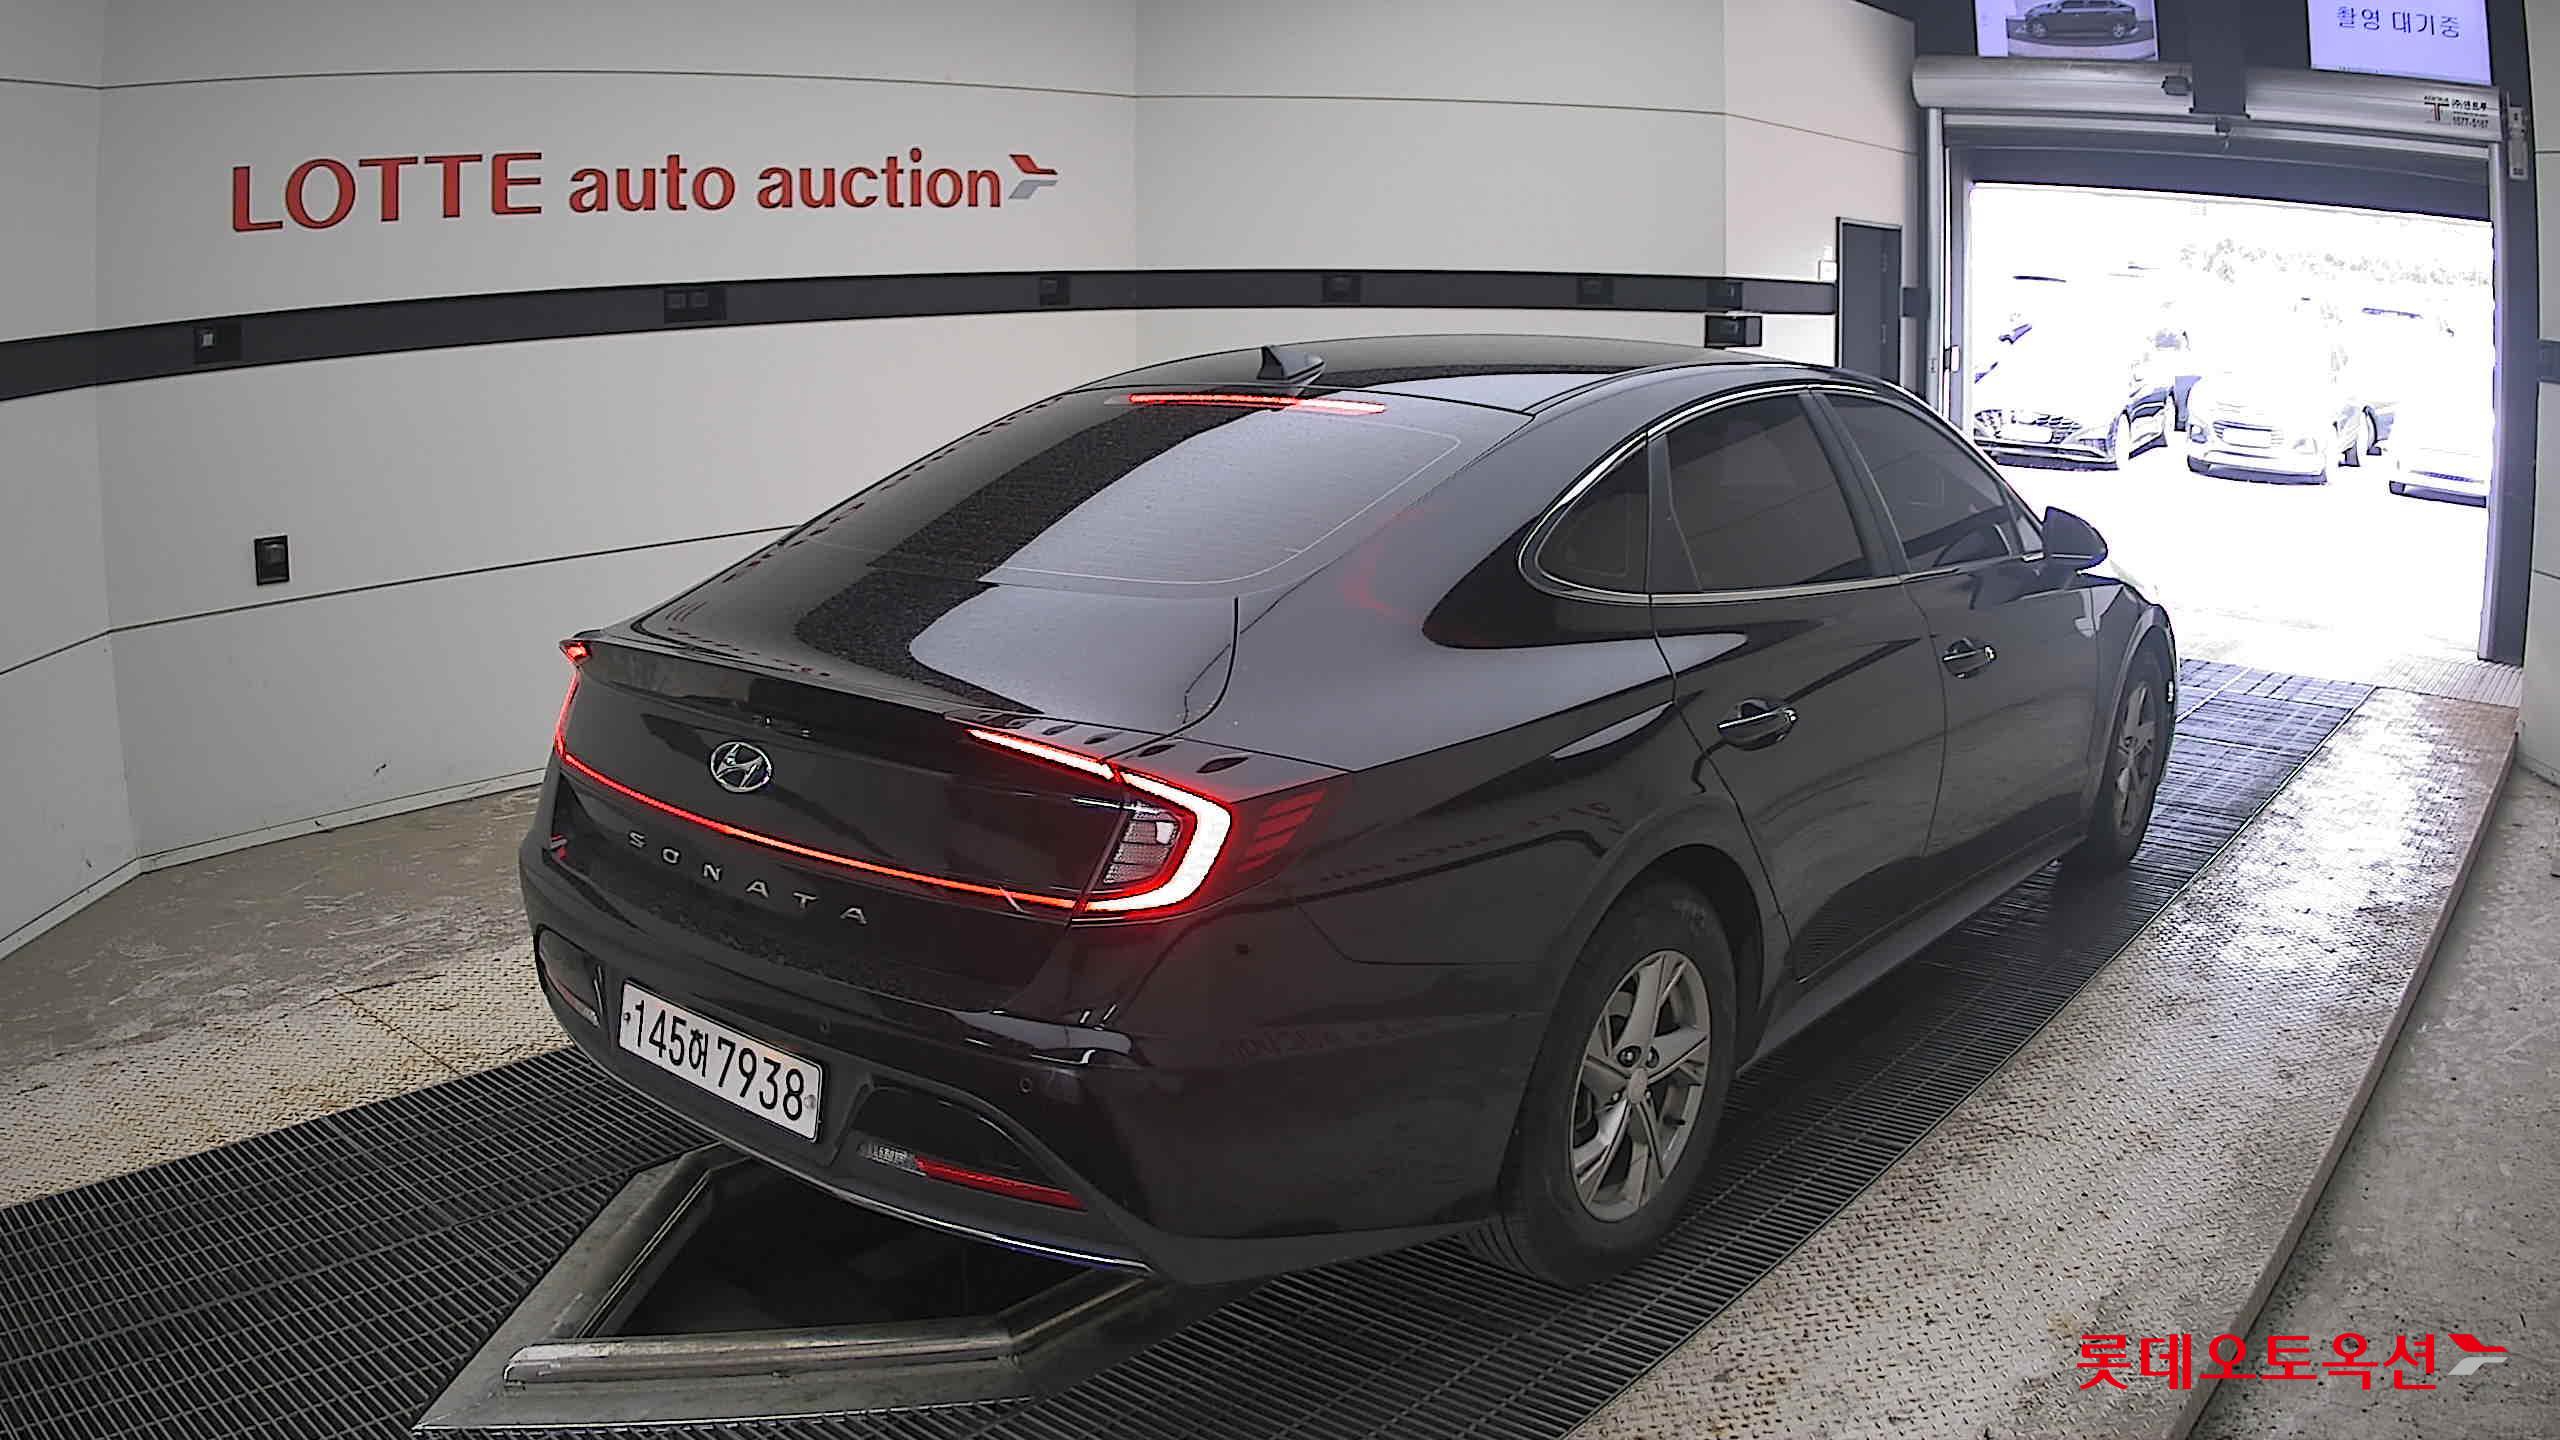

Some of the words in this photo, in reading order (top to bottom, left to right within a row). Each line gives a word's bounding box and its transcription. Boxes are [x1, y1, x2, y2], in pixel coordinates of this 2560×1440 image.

[2337, 6, 2380, 31] 촬영
[233, 152, 544, 232] LOTTE
[569, 155, 737, 213] auto
[758, 148, 1001, 208] auction
[628, 831, 868, 925] SONATA
